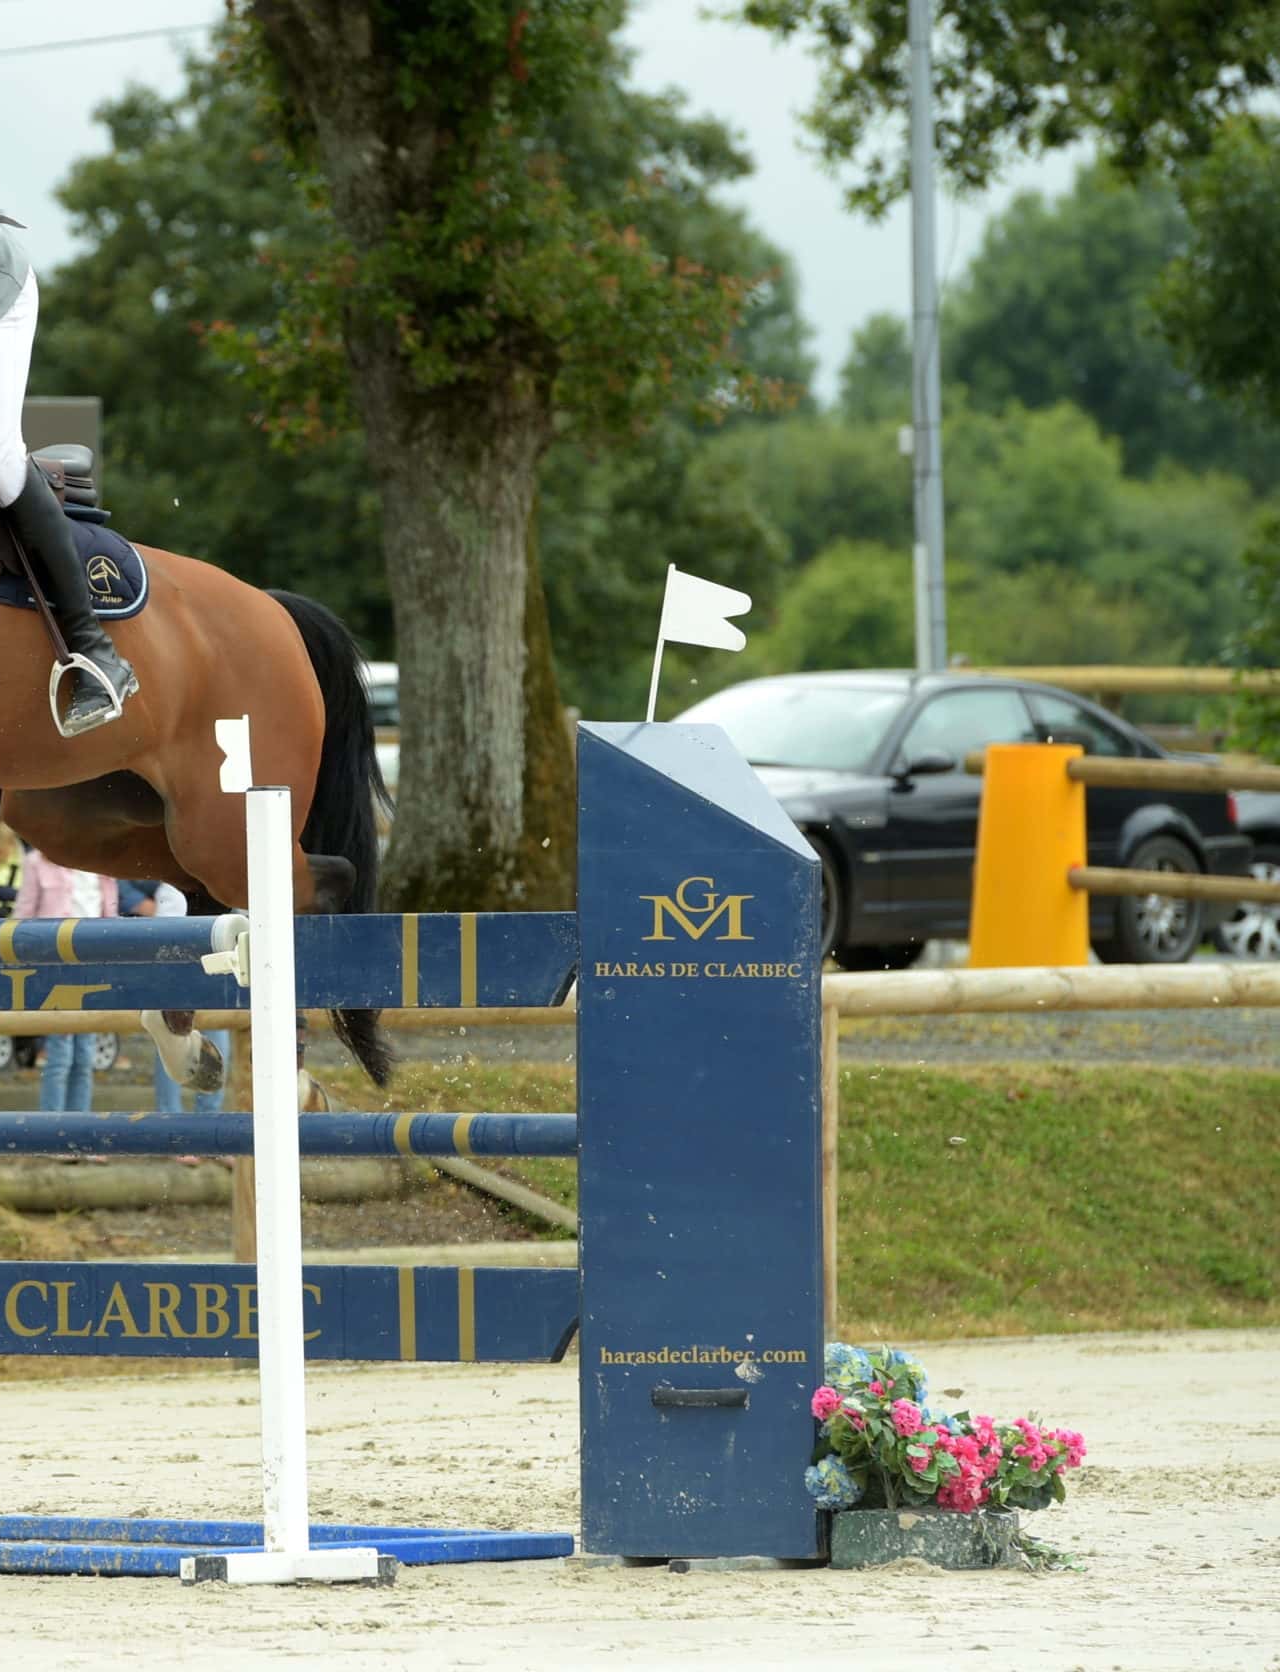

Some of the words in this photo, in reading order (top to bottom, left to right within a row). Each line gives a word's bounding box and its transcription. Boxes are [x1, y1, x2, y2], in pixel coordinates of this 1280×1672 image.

[595, 962, 665, 978] HARAS
[671, 962, 698, 978] DE
[704, 962, 802, 978] CLARBEC
[600, 1345, 807, 1364] harasdeclarbec.com
